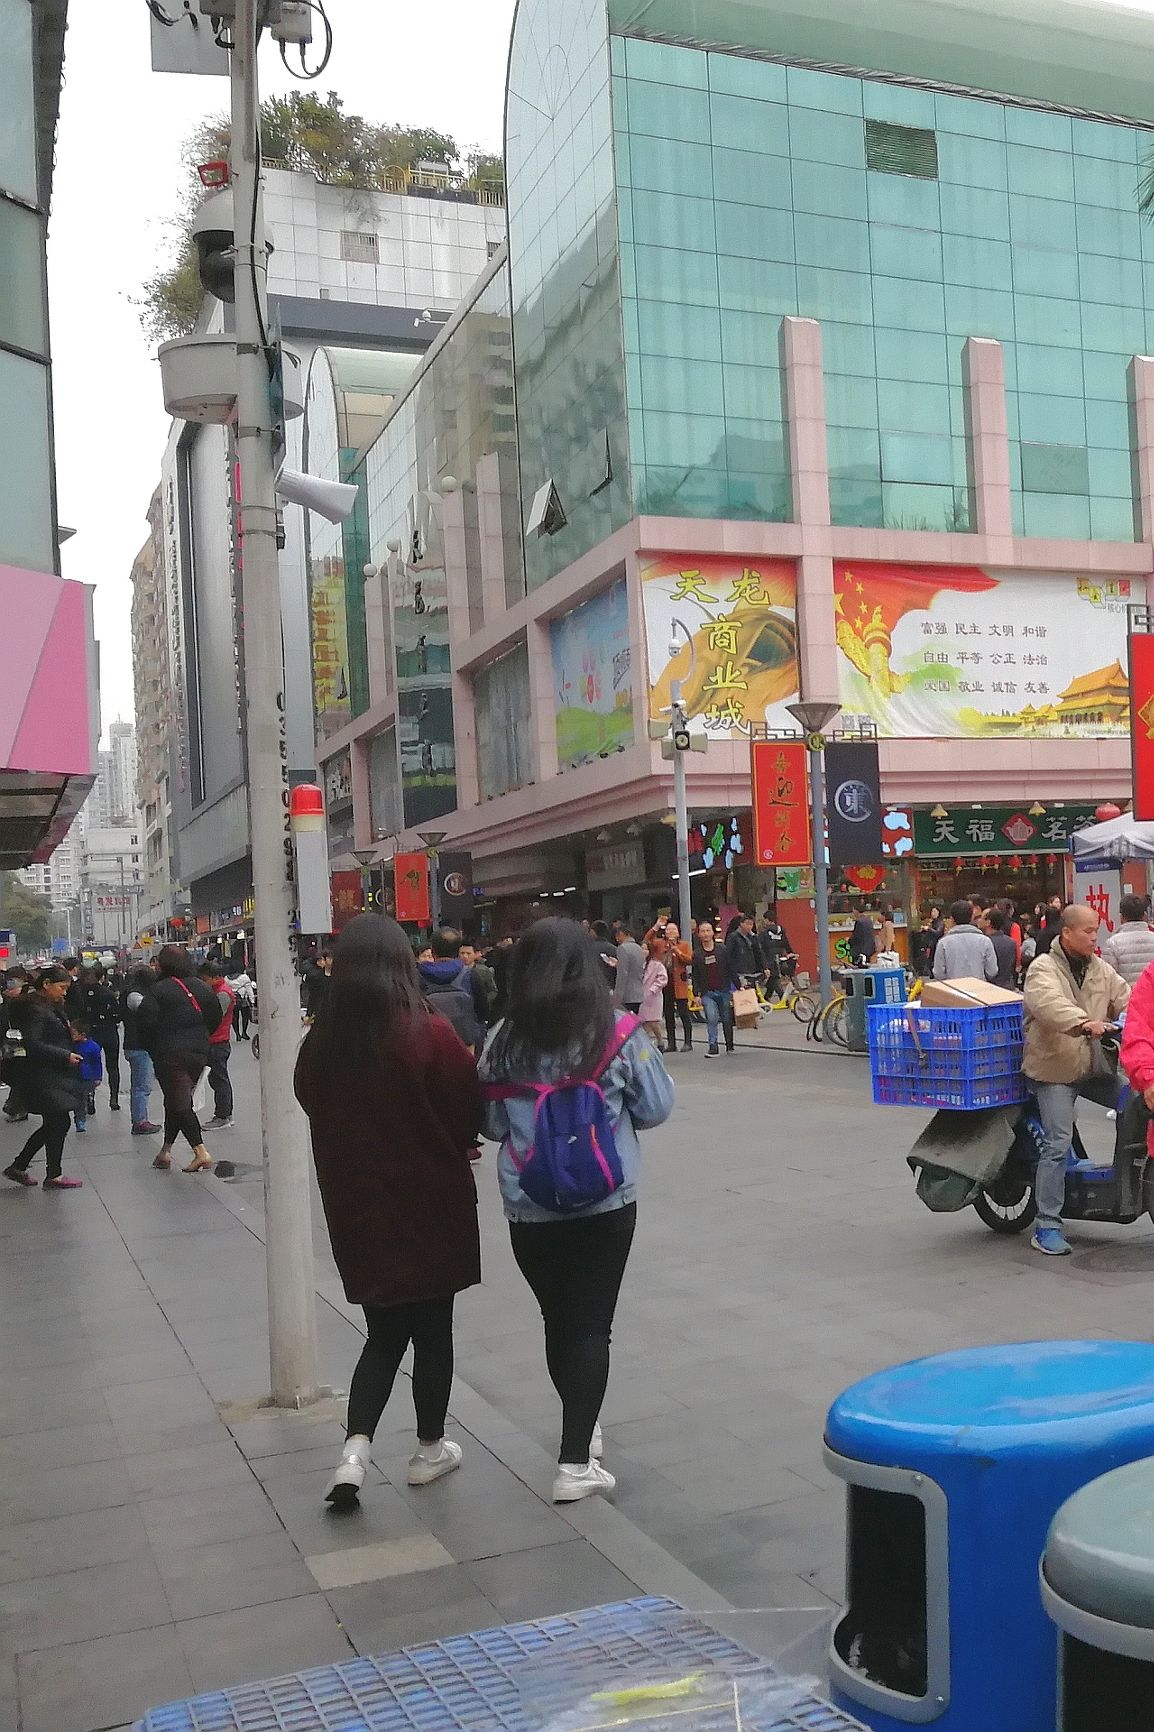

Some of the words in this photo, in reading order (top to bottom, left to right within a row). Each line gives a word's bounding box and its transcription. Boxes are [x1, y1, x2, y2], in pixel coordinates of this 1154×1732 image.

[670, 568, 770, 605] 天龙
[920, 622, 948, 636] 富强
[955, 623, 982, 636] 民主
[989, 624, 1015, 637] 文明
[1022, 625, 1048, 638] 和谐
[923, 651, 949, 664] 自由
[956, 651, 983, 665] 平等
[990, 652, 1016, 665] 公正
[1023, 653, 1048, 666] 法治
[700, 613, 751, 737] 商业城
[958, 680, 985, 693] 敬业
[991, 681, 1018, 694] 诚信
[1024, 681, 1050, 694] 友善
[932, 818, 995, 844] 天福
